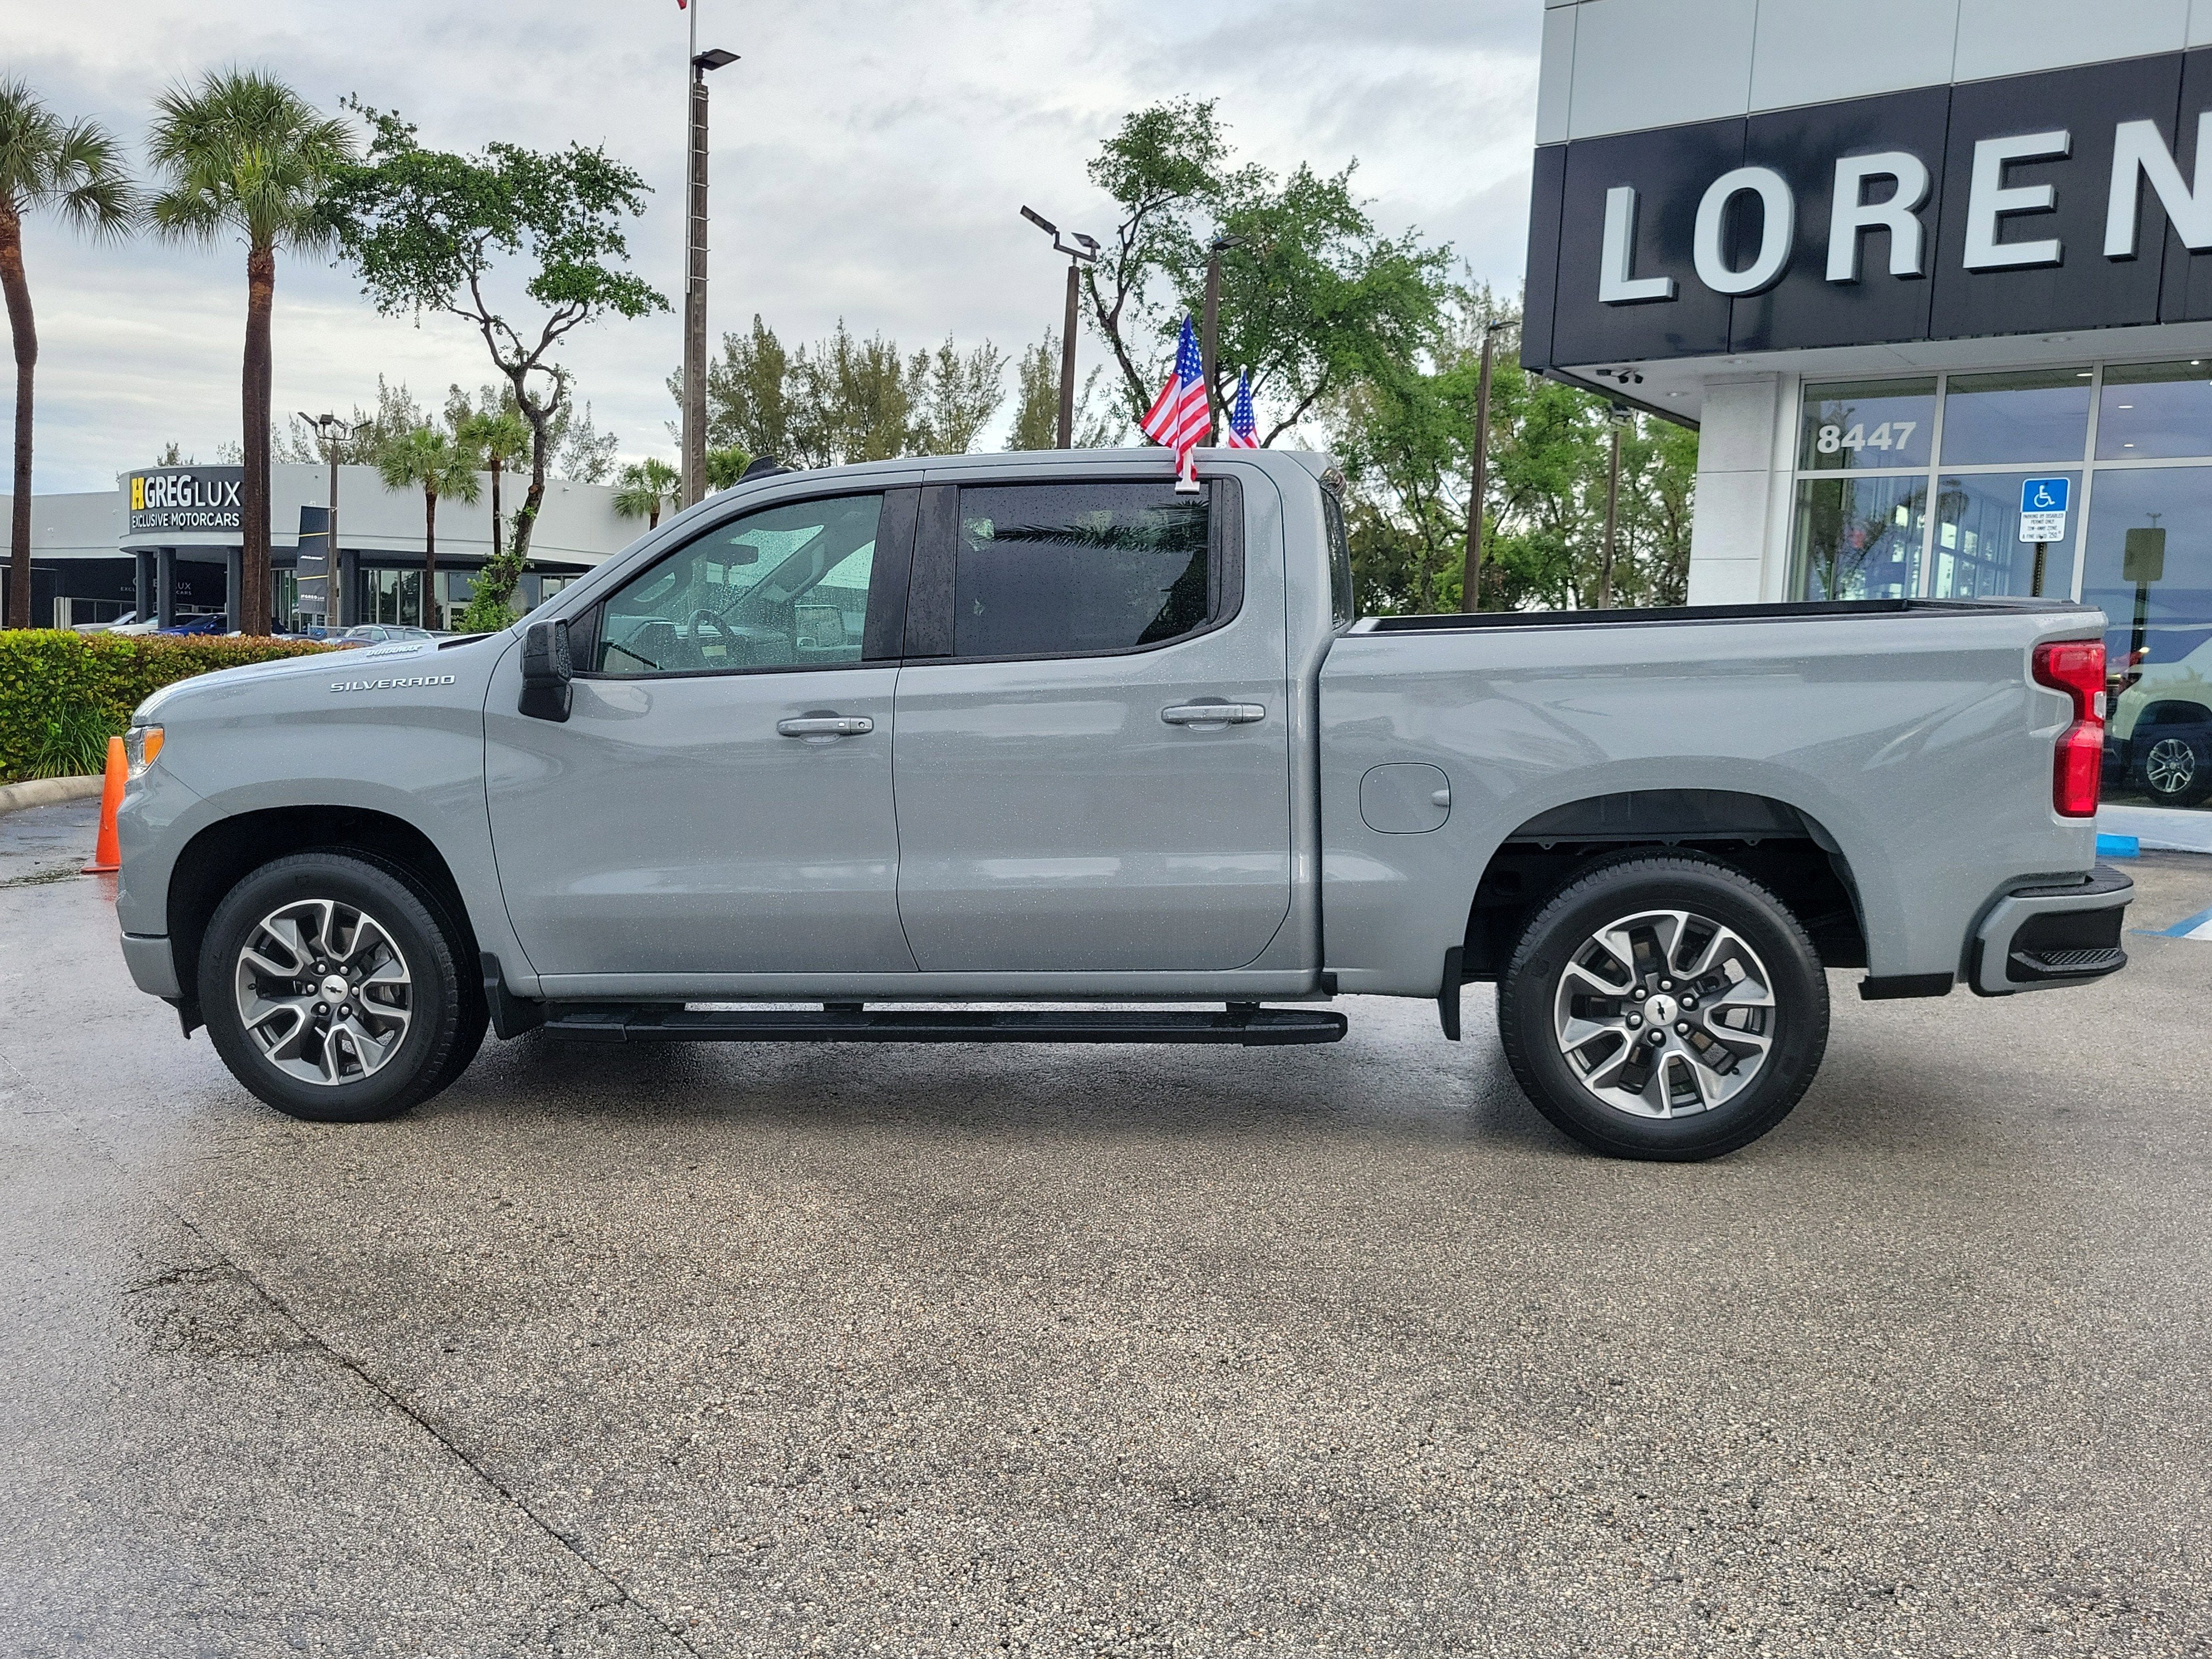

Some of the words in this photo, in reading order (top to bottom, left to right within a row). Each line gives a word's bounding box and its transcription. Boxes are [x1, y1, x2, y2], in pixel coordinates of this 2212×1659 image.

[1598, 111, 2212, 305] LOREN
[1817, 421, 1916, 453] 8447
[132, 513, 168, 528] EXCLUSIVE
[171, 512, 240, 527] MOTORCARS
[330, 675, 455, 692] SILVERADO
